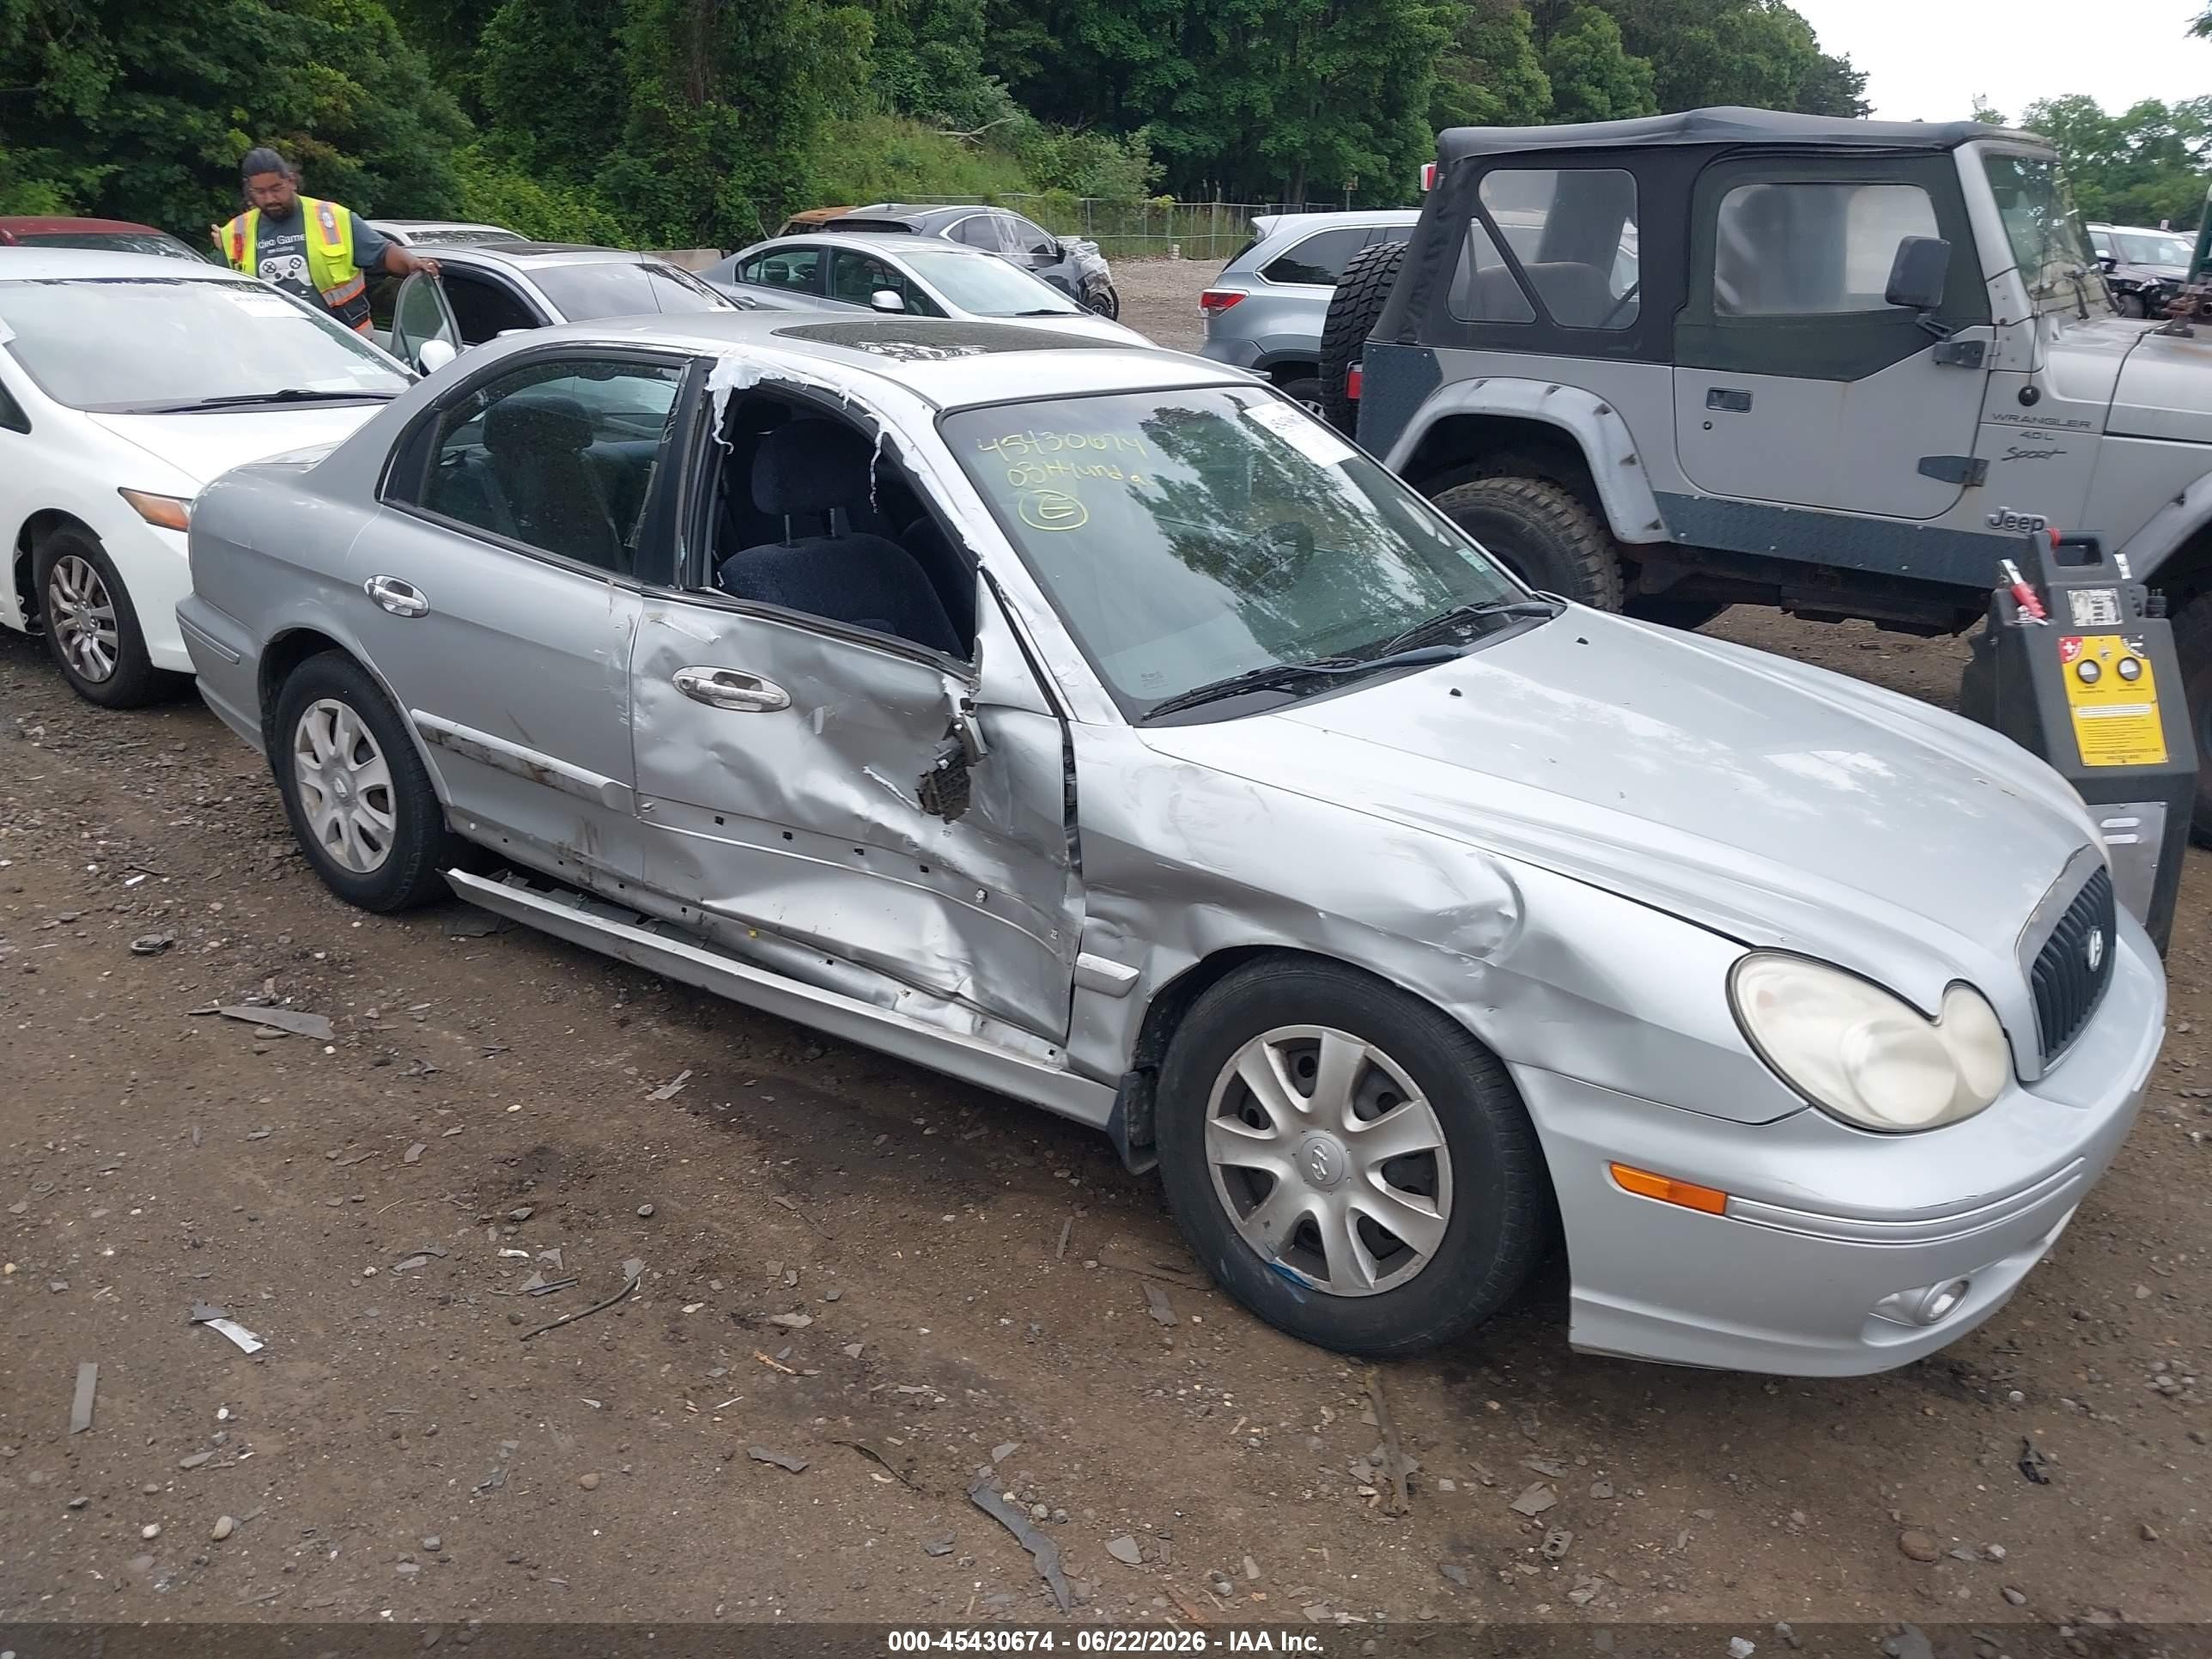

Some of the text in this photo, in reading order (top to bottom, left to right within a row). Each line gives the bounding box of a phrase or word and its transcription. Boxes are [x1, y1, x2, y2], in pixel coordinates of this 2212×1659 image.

[1992, 413, 2092, 428] WRANGLER
[976, 429, 1148, 462] 45430674
[2001, 447, 2068, 461] Sport
[1986, 506, 2049, 533] Jeep
